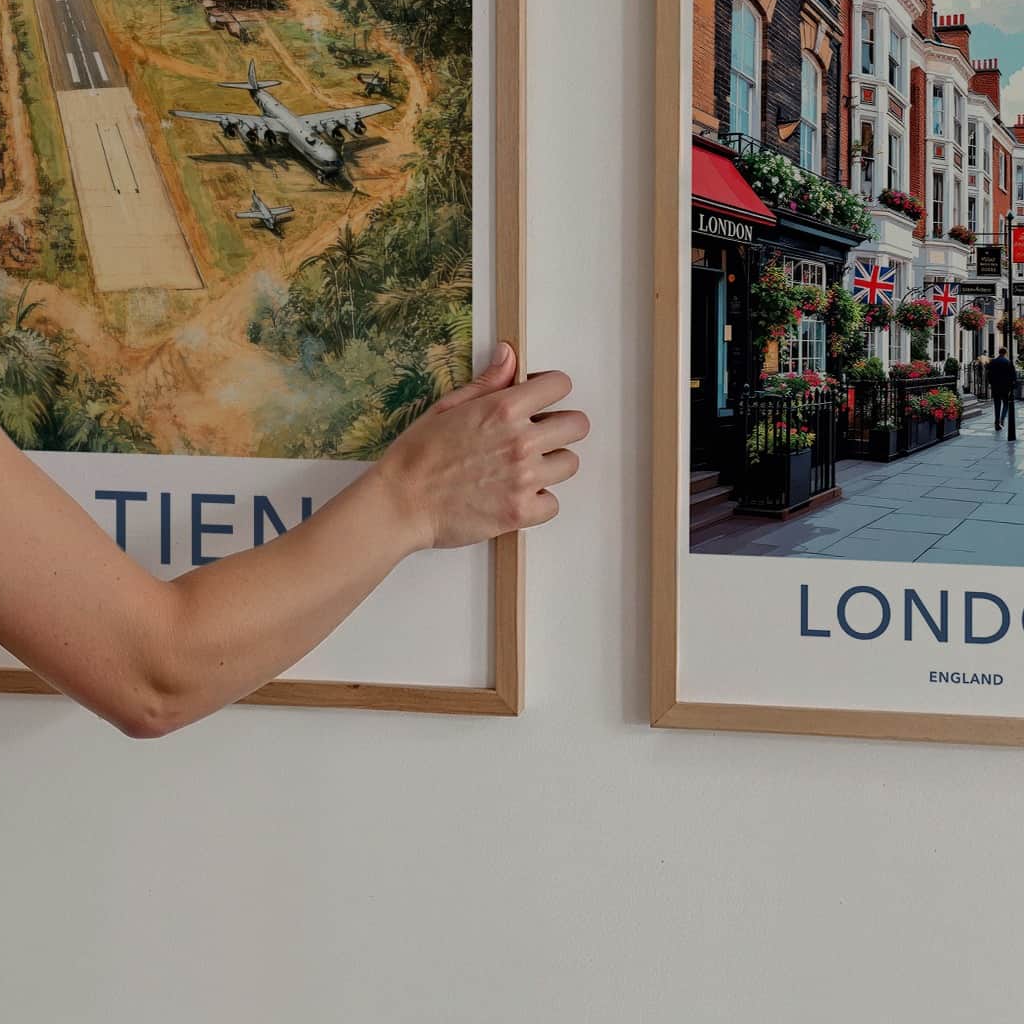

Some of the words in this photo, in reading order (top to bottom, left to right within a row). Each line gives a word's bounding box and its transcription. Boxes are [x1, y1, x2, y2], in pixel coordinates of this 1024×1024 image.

[698, 213, 753, 242] LONDON
[800, 584, 1024, 644] LOND
[929, 670, 1004, 686] ENGLAND
